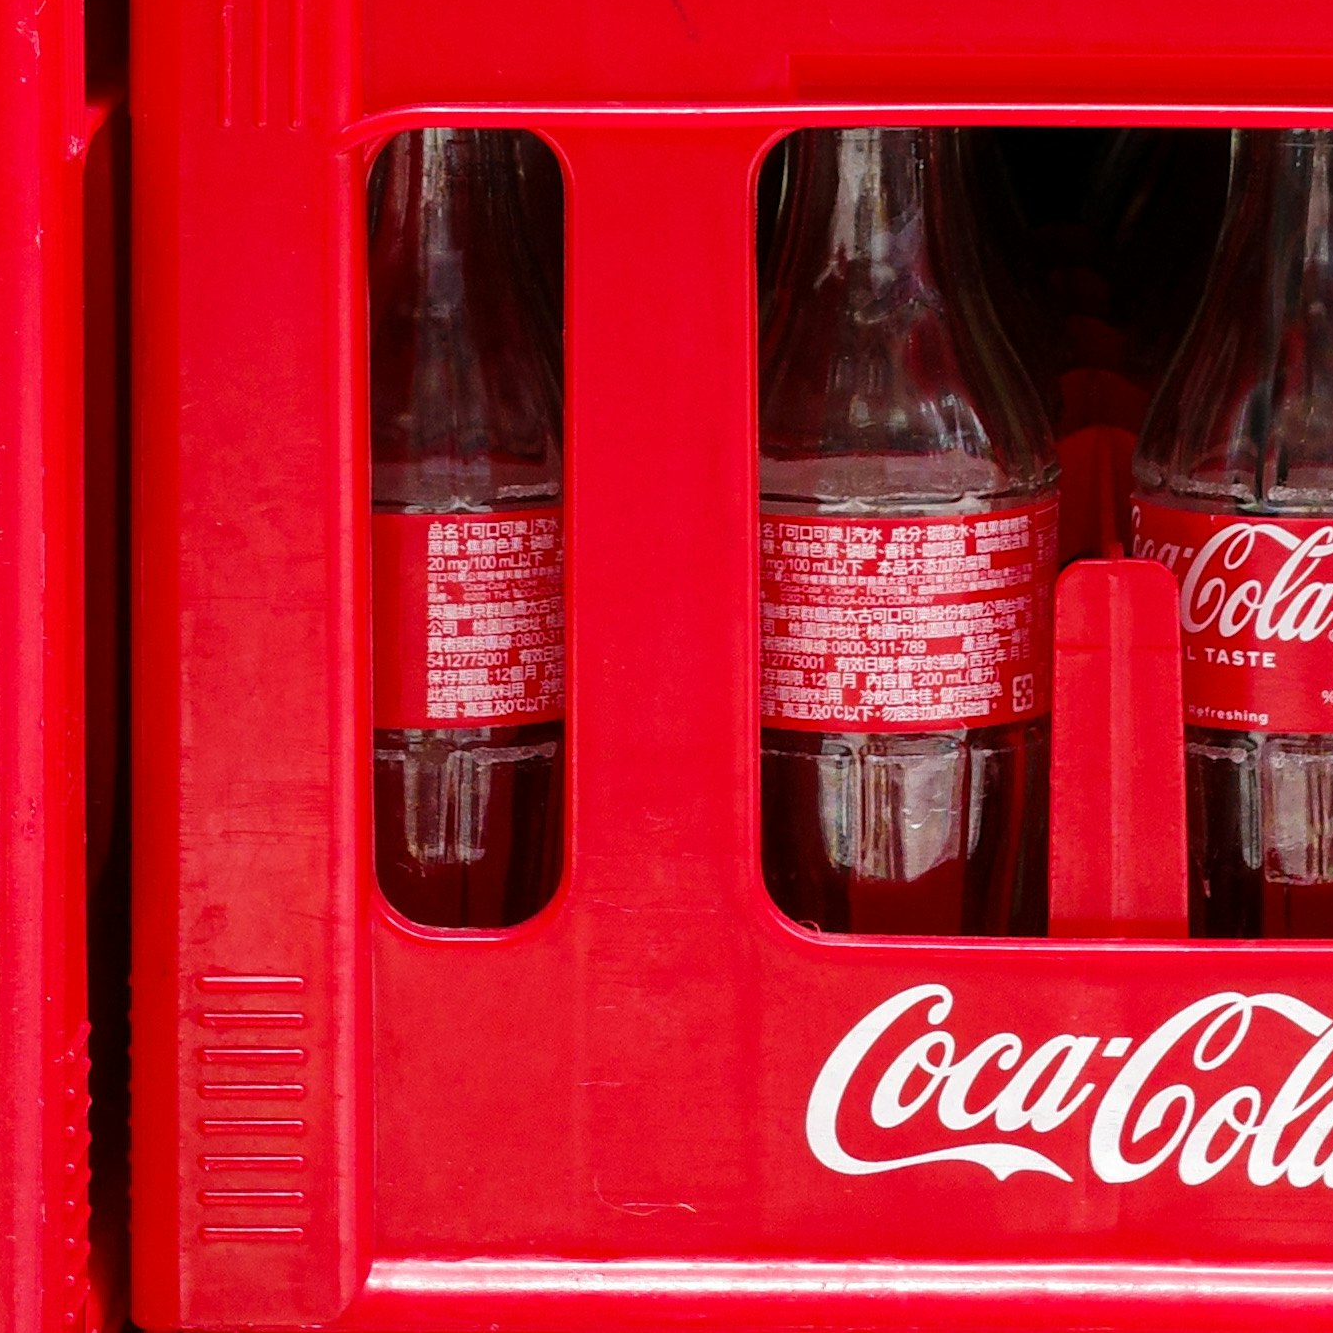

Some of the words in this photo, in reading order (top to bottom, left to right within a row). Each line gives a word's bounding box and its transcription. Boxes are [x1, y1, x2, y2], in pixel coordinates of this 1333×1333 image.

[427, 556, 446, 571] 20
[1204, 647, 1277, 669] TASTE
[1189, 703, 1269, 726] Refreshing
